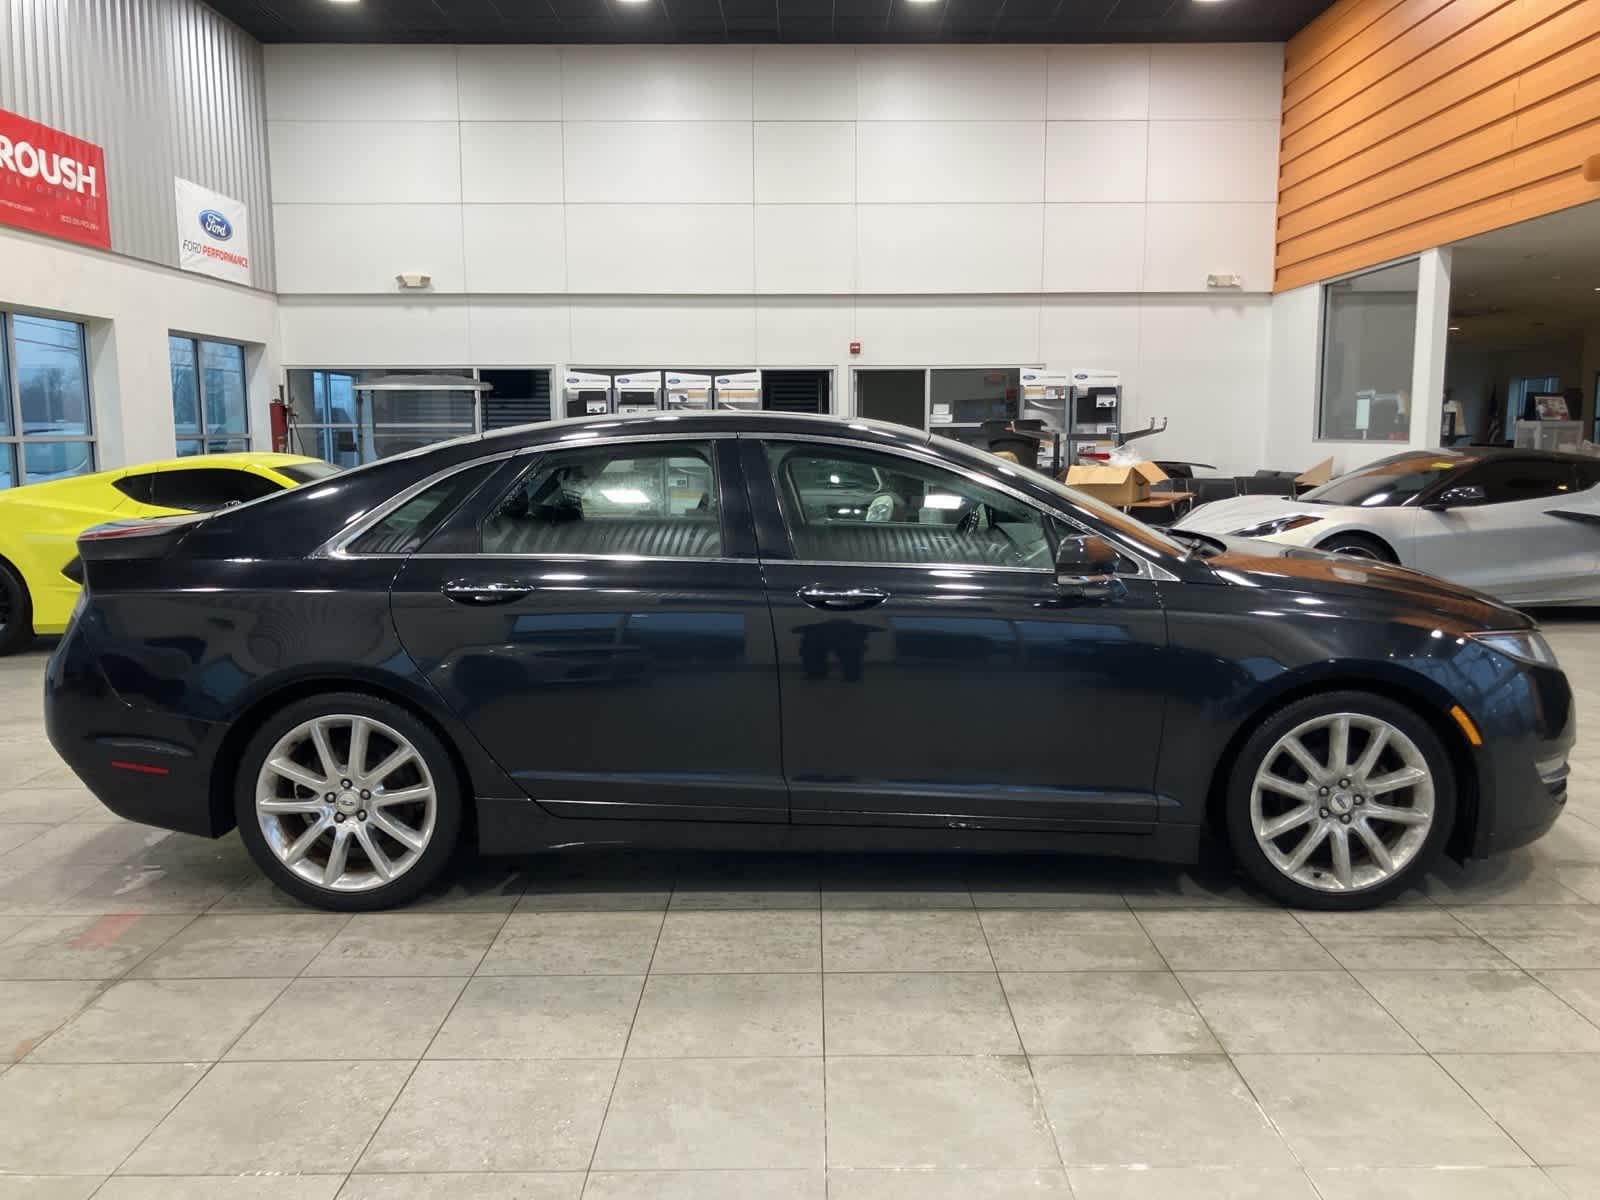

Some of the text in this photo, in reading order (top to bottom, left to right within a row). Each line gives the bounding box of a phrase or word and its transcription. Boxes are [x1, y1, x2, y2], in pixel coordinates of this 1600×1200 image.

[0, 134, 96, 197] ROUSH
[206, 213, 226, 237] Ford
[182, 239, 249, 269] FORD PERFORMANCE
